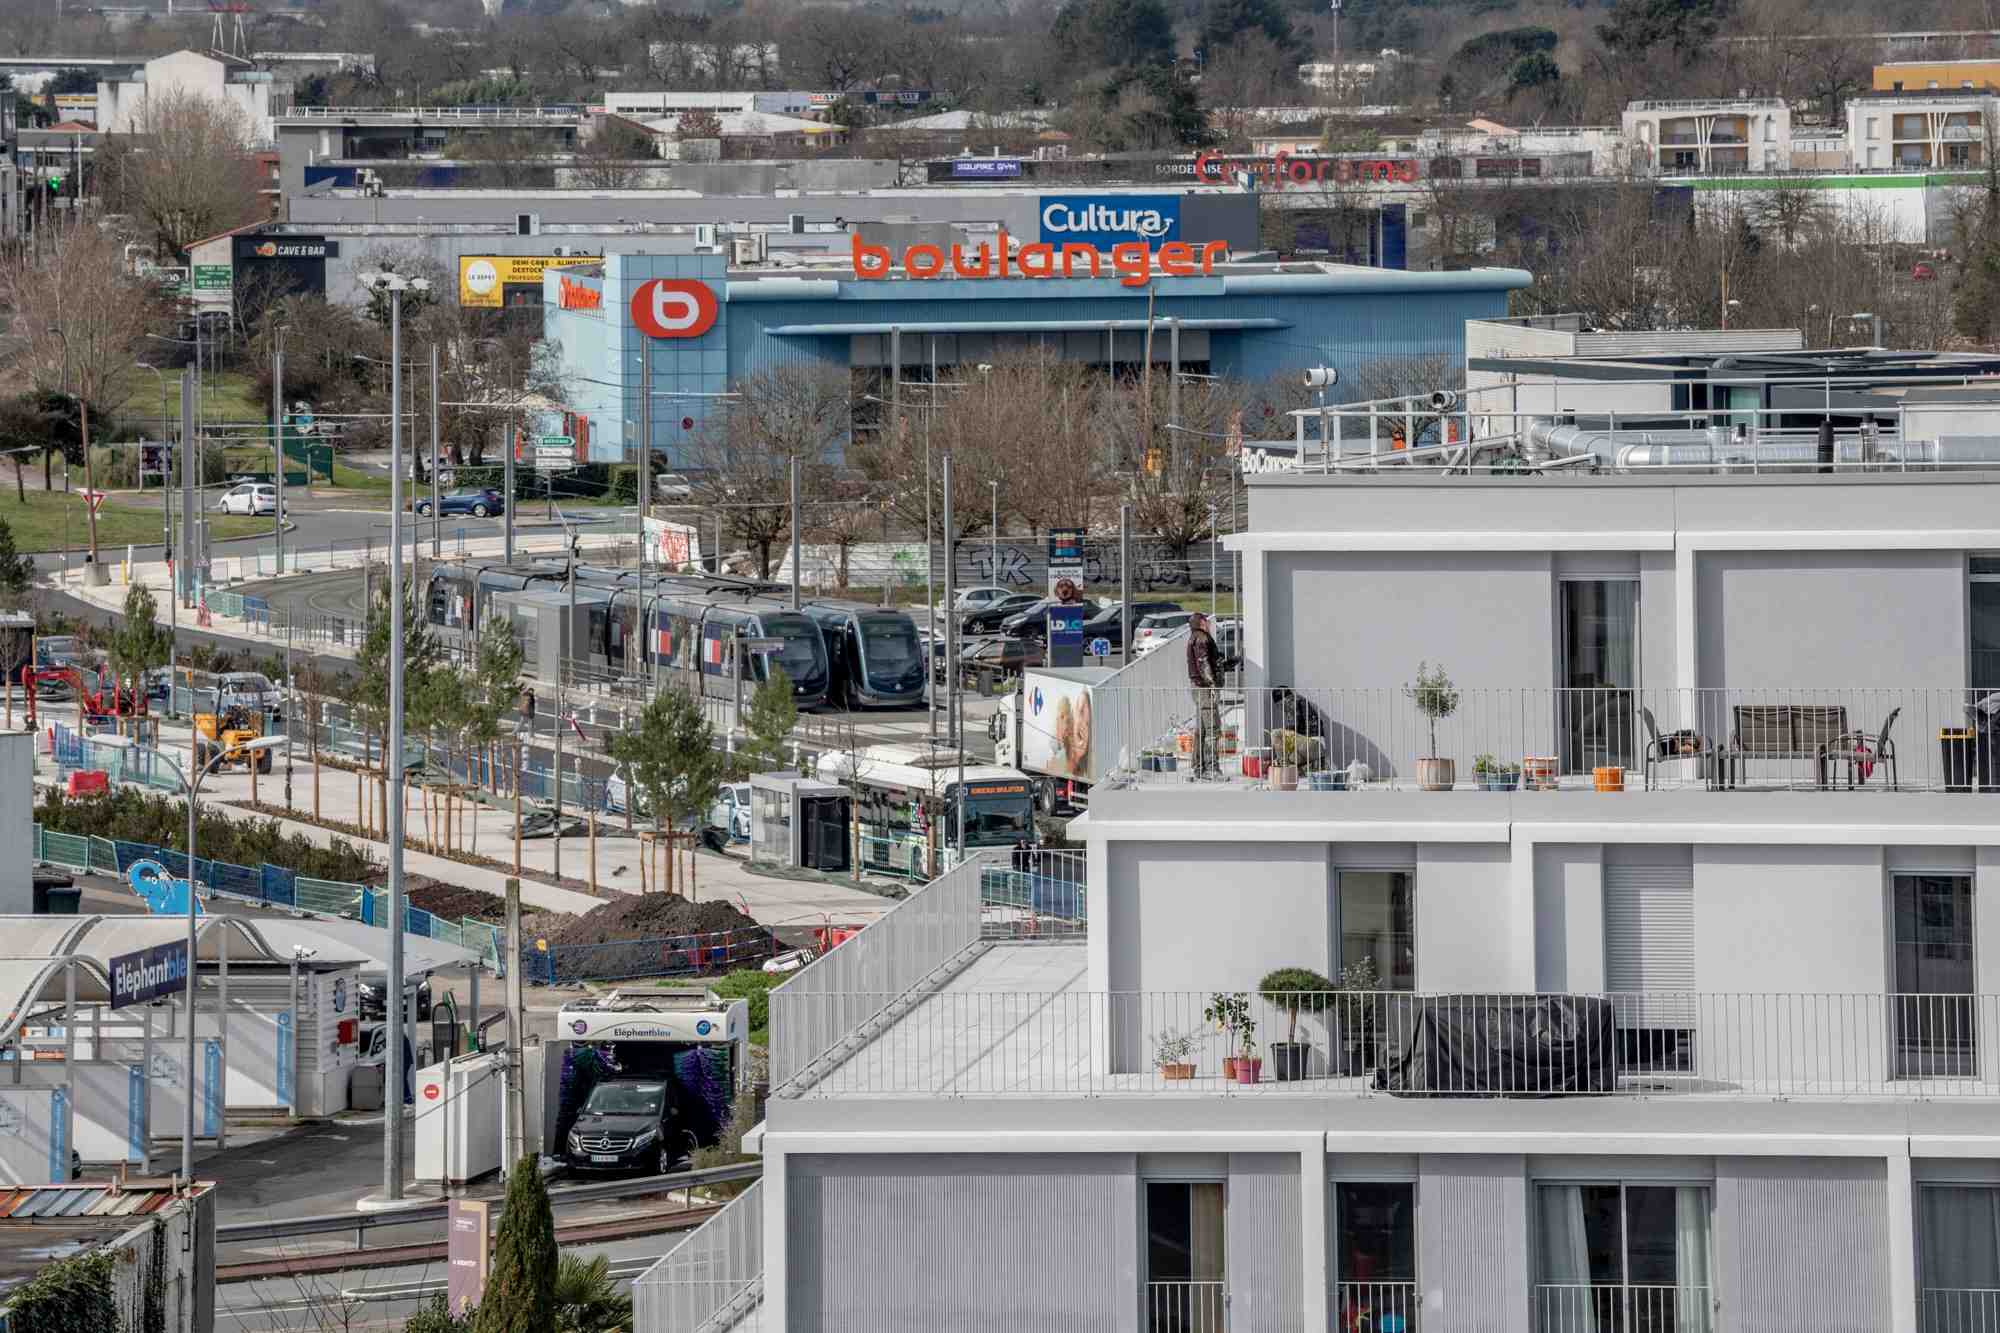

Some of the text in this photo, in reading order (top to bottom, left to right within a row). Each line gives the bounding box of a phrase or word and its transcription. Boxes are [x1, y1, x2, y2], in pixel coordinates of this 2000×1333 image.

[1043, 203, 1172, 236] Cultura
[278, 246, 300, 256] CAVE
[308, 246, 326, 256] BAR
[852, 232, 1229, 288] boulanger
[652, 280, 700, 330] b
[1050, 619, 1082, 631] LDLC
[115, 950, 187, 1000] Eléphantble
